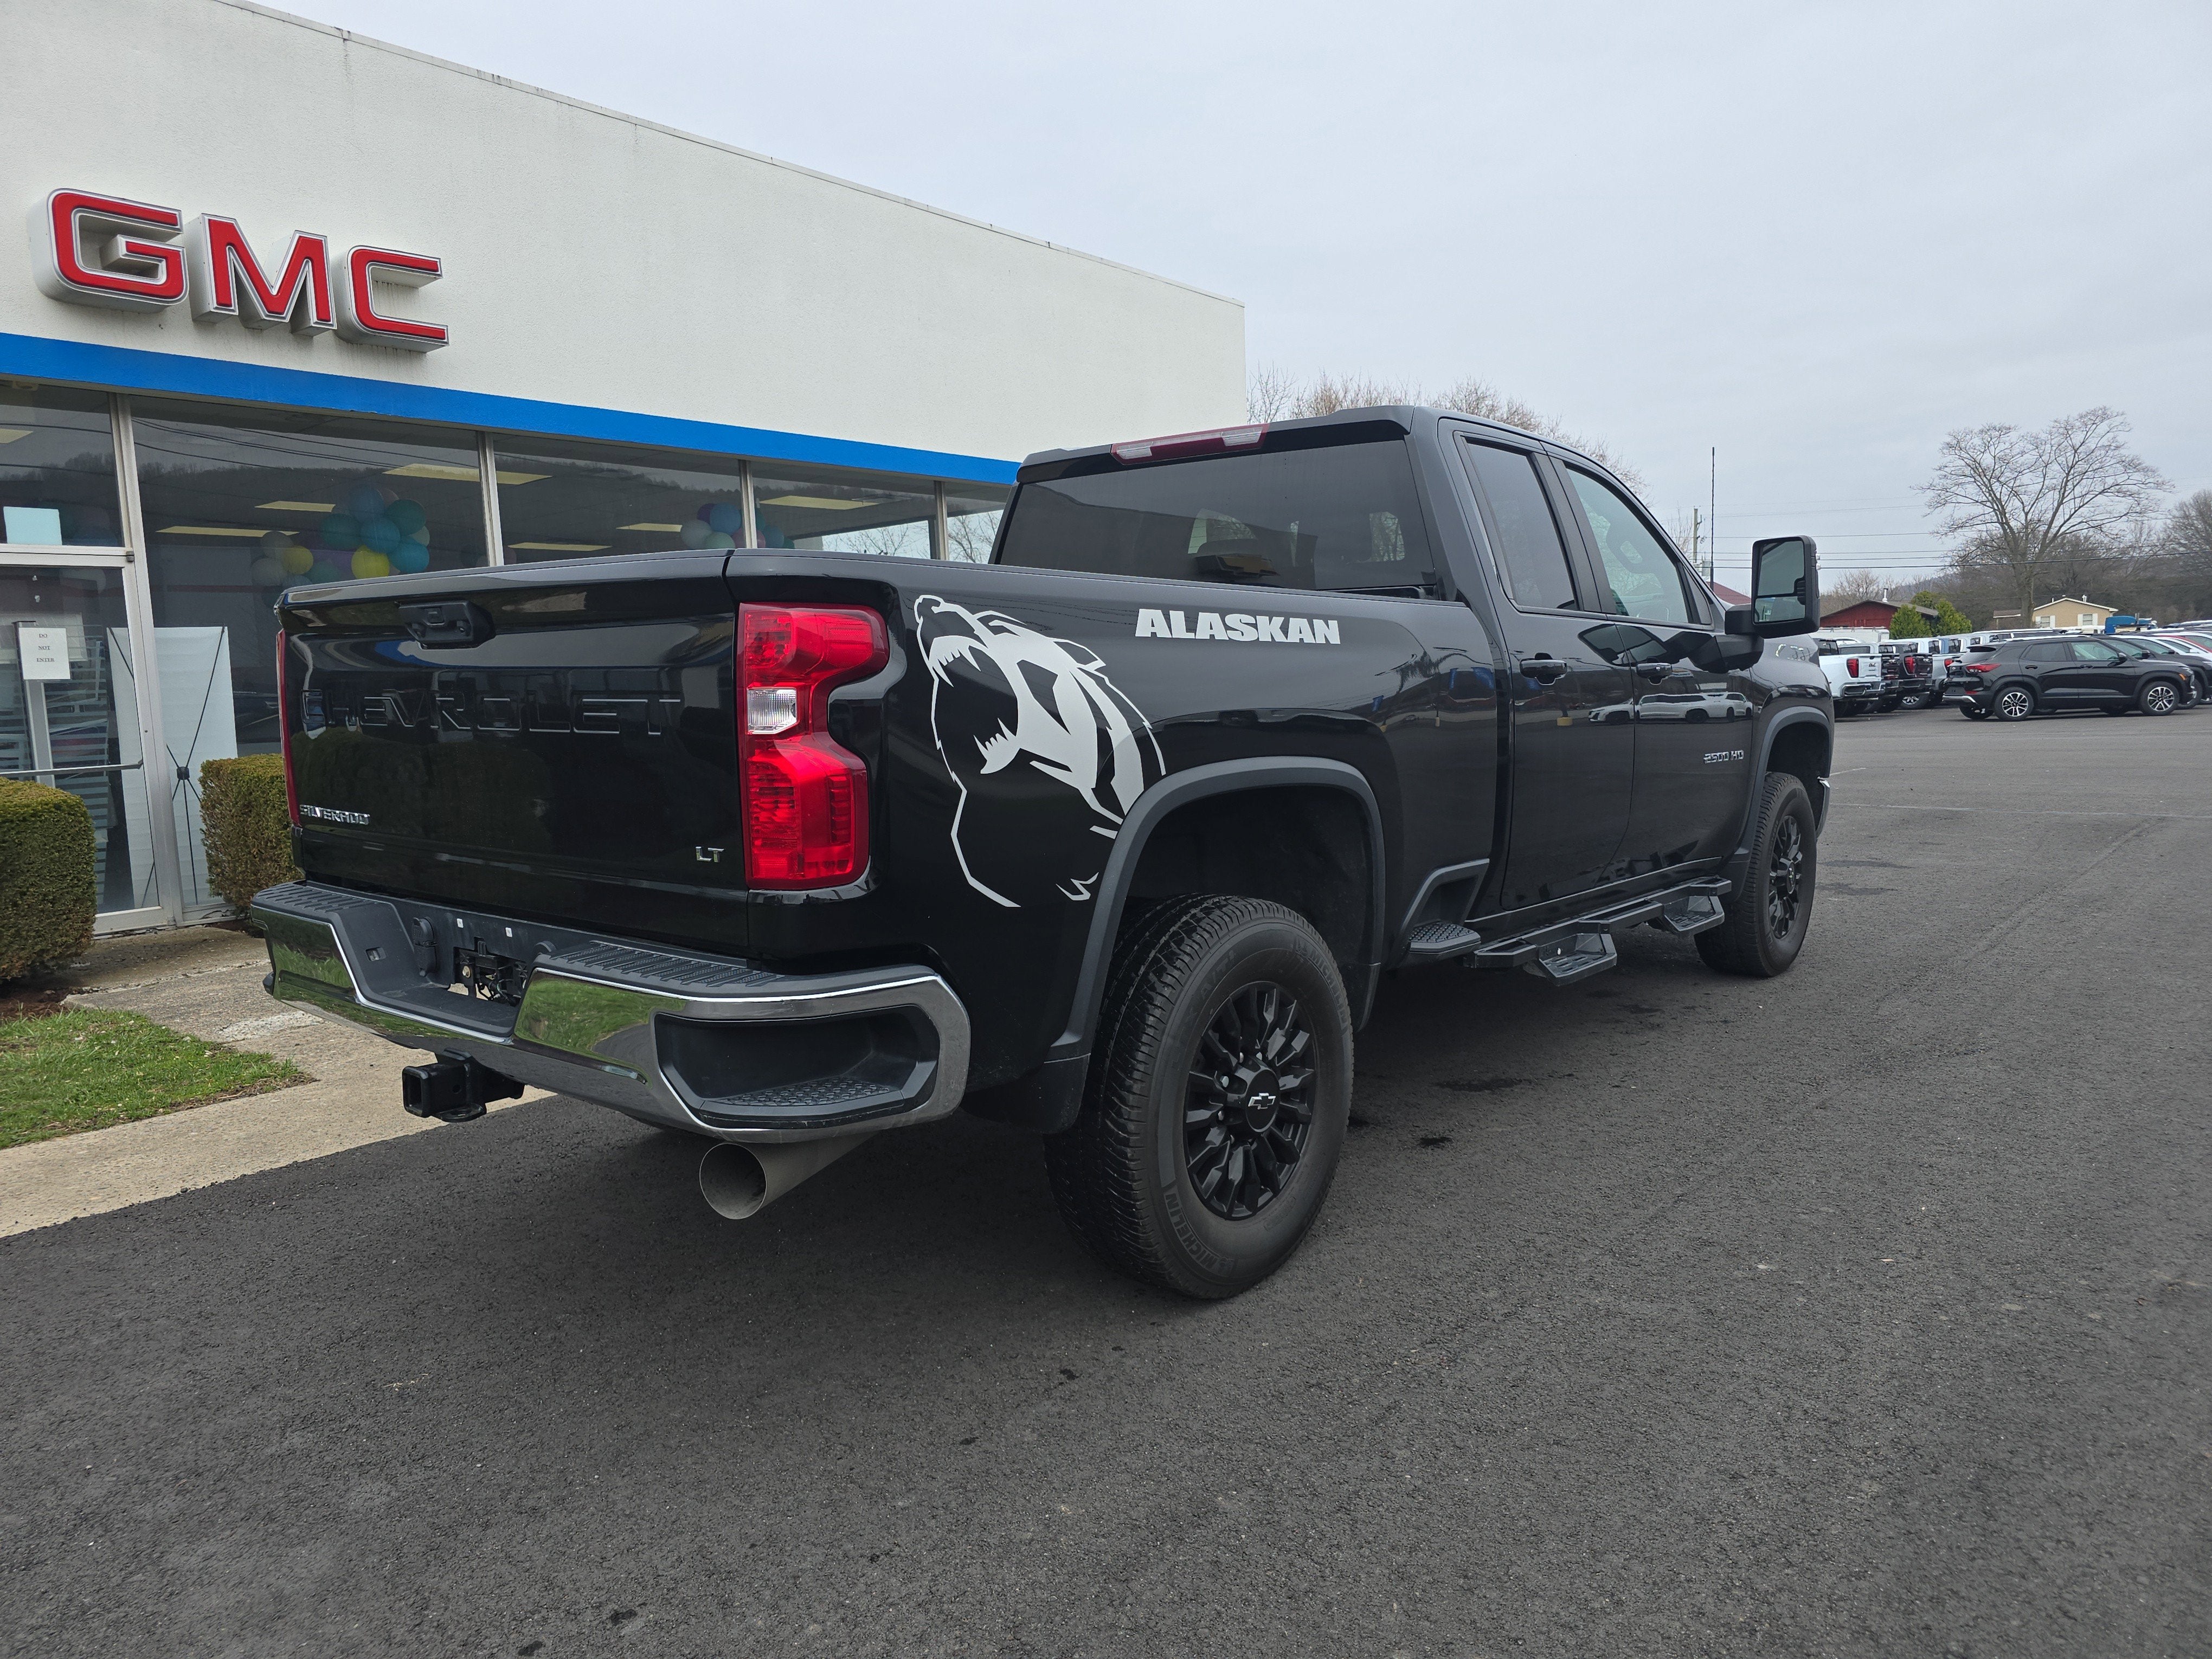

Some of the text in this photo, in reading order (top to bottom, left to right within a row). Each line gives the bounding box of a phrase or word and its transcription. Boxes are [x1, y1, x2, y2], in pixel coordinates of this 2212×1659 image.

[47, 188, 449, 348] GMC
[1135, 608, 1341, 644] ALASKAN
[300, 689, 681, 736] CHEVROLET
[1703, 749, 1745, 764] 2500 HD
[299, 804, 370, 825] SILVERADO
[695, 846, 725, 863] LT
[1307, 949, 1348, 1025] MICHELIN
[1165, 1191, 1220, 1271] MICHELIN
